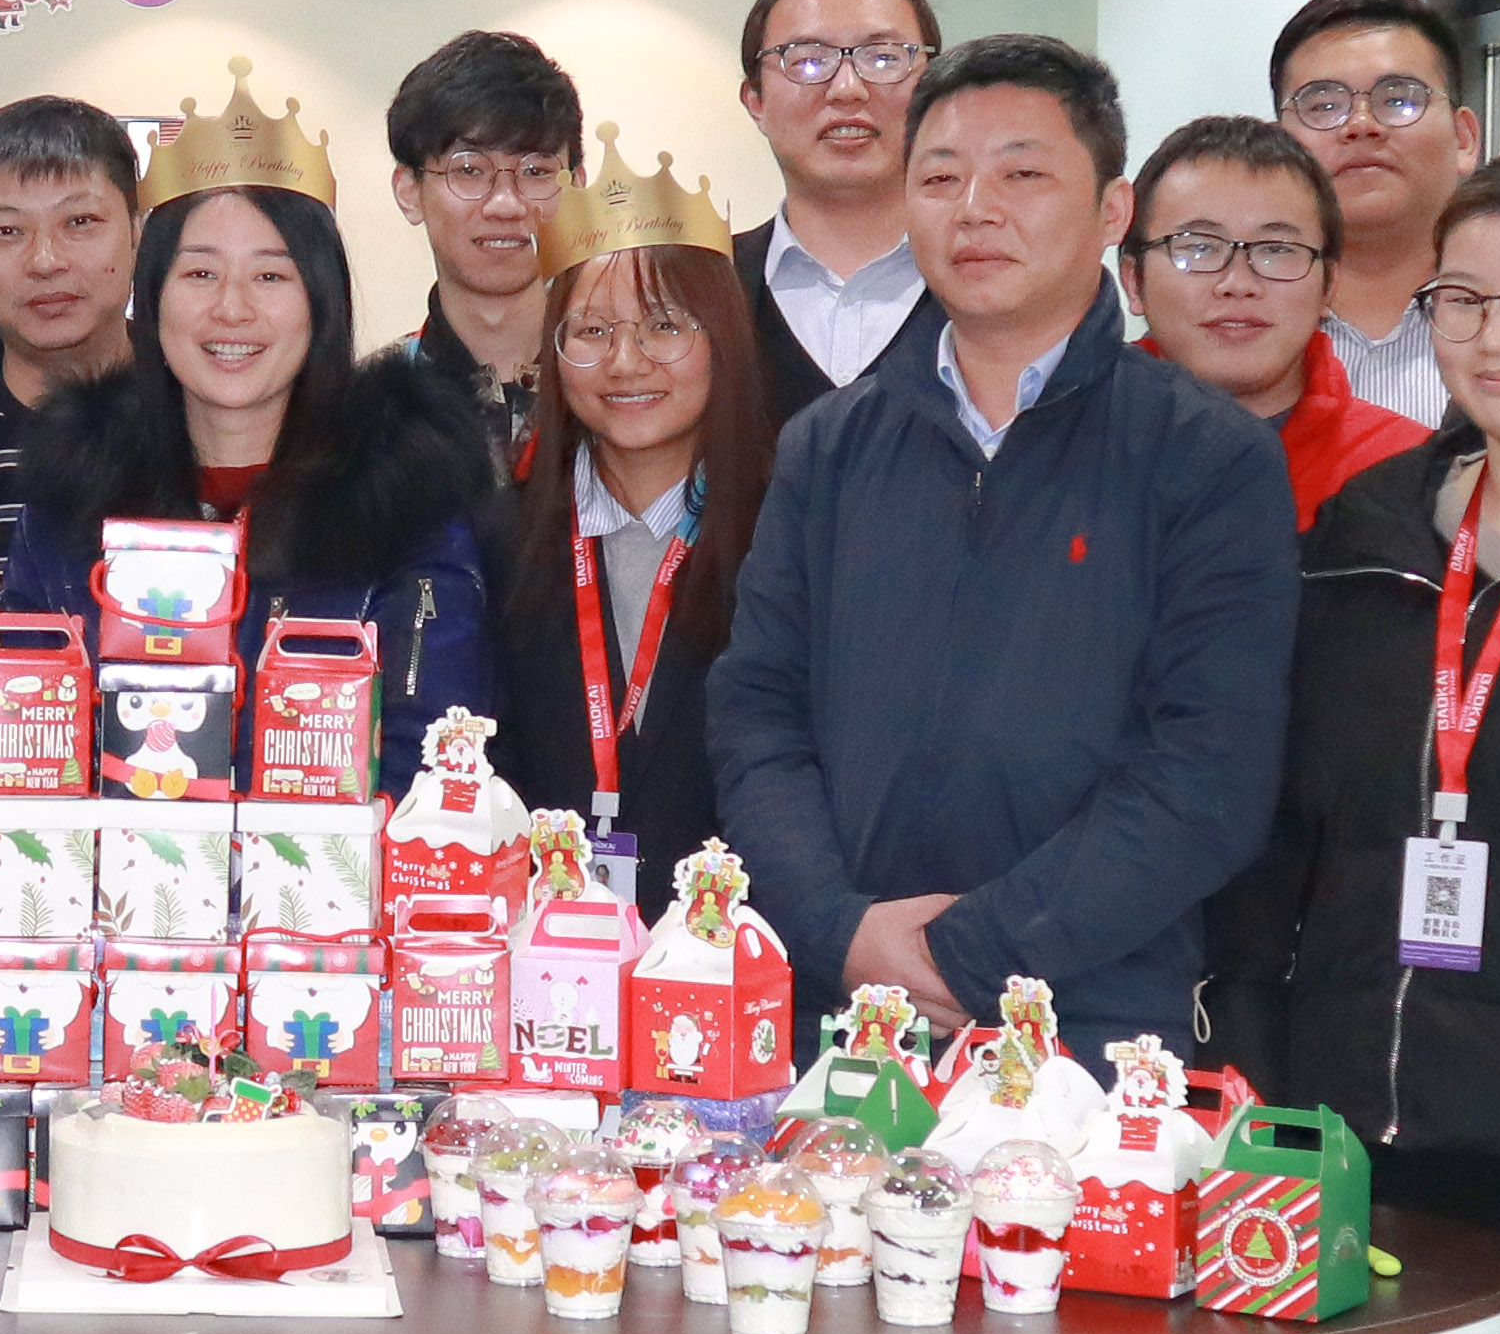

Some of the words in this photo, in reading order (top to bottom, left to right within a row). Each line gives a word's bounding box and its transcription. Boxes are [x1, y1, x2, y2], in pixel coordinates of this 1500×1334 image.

[22, 705, 77, 721] MERRY
[300, 713, 355, 729] MERRY
[264, 729, 353, 767] CHRISTMAS
[393, 859, 426, 875] Merry
[391, 872, 450, 891] Christmas
[438, 988, 494, 1005] MERRY
[402, 1007, 492, 1043] CHRISTMAS
[514, 1019, 613, 1055] NOEL
[554, 1061, 588, 1074] WINTER
[569, 1073, 604, 1086] COMING
[1075, 1205, 1100, 1219] erry
[1070, 1219, 1129, 1235] hristmas
